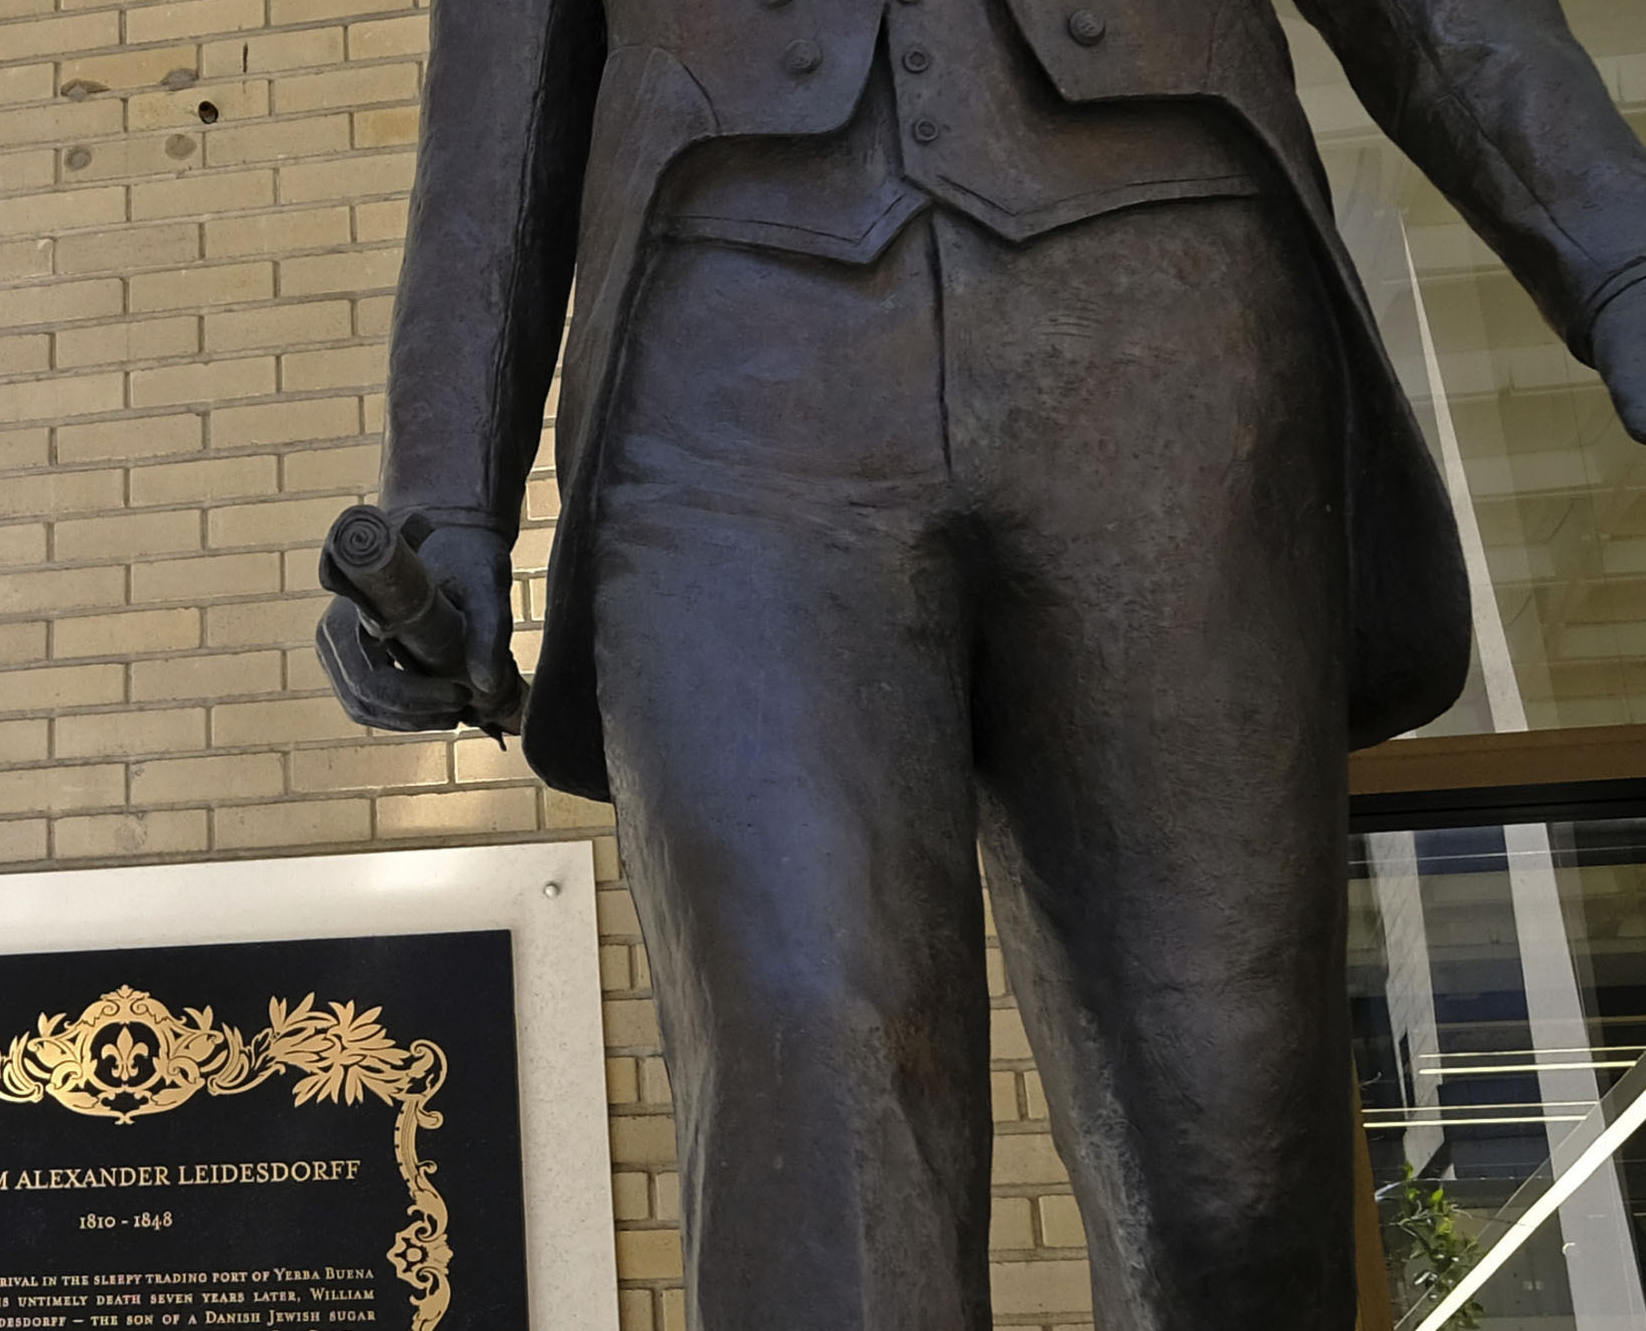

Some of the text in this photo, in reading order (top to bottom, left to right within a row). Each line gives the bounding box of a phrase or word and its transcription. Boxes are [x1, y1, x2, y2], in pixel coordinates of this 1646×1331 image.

[14, 1166, 171, 1190] ALEXANDER
[178, 1160, 361, 1185] LEIDESDORFF
[79, 1211, 173, 1231] 1810 1848
